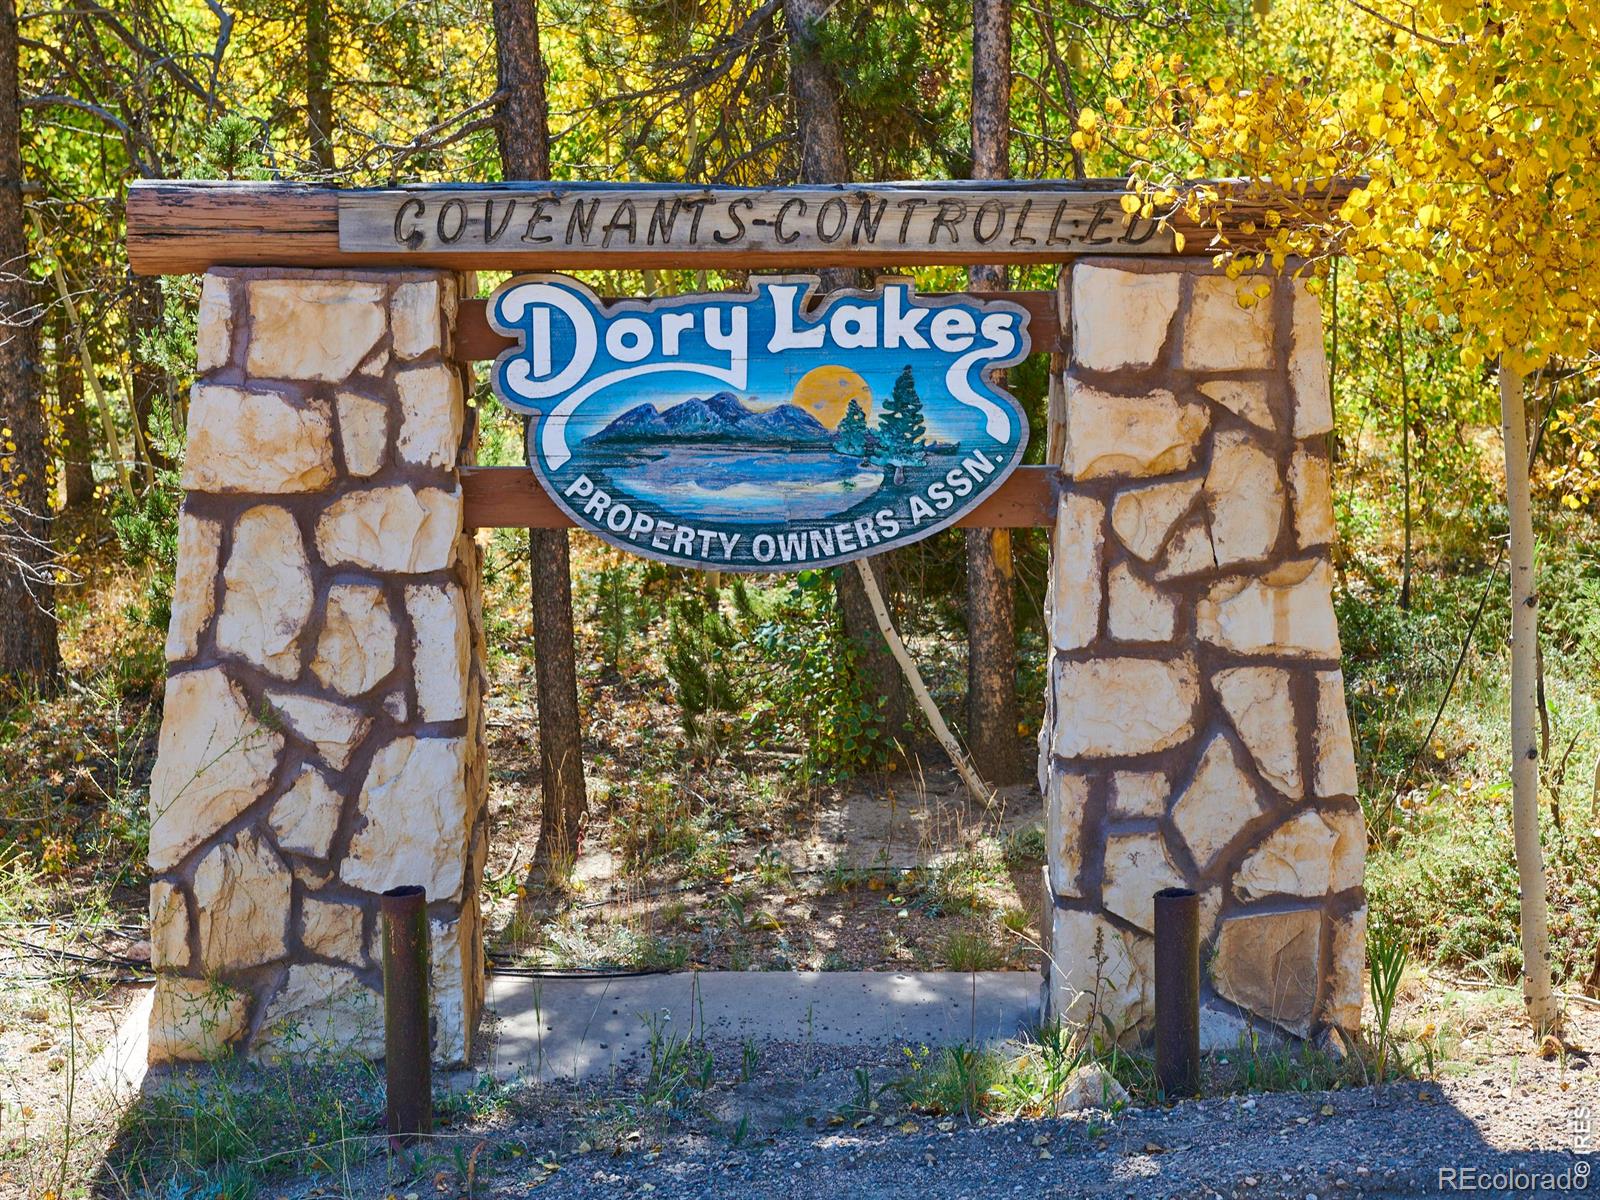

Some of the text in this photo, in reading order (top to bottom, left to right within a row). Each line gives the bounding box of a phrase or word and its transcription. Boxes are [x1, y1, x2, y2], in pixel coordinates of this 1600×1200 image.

[501, 283, 748, 472] Dory
[564, 448, 1004, 563] PROPERTY OWNERS ASSN.
